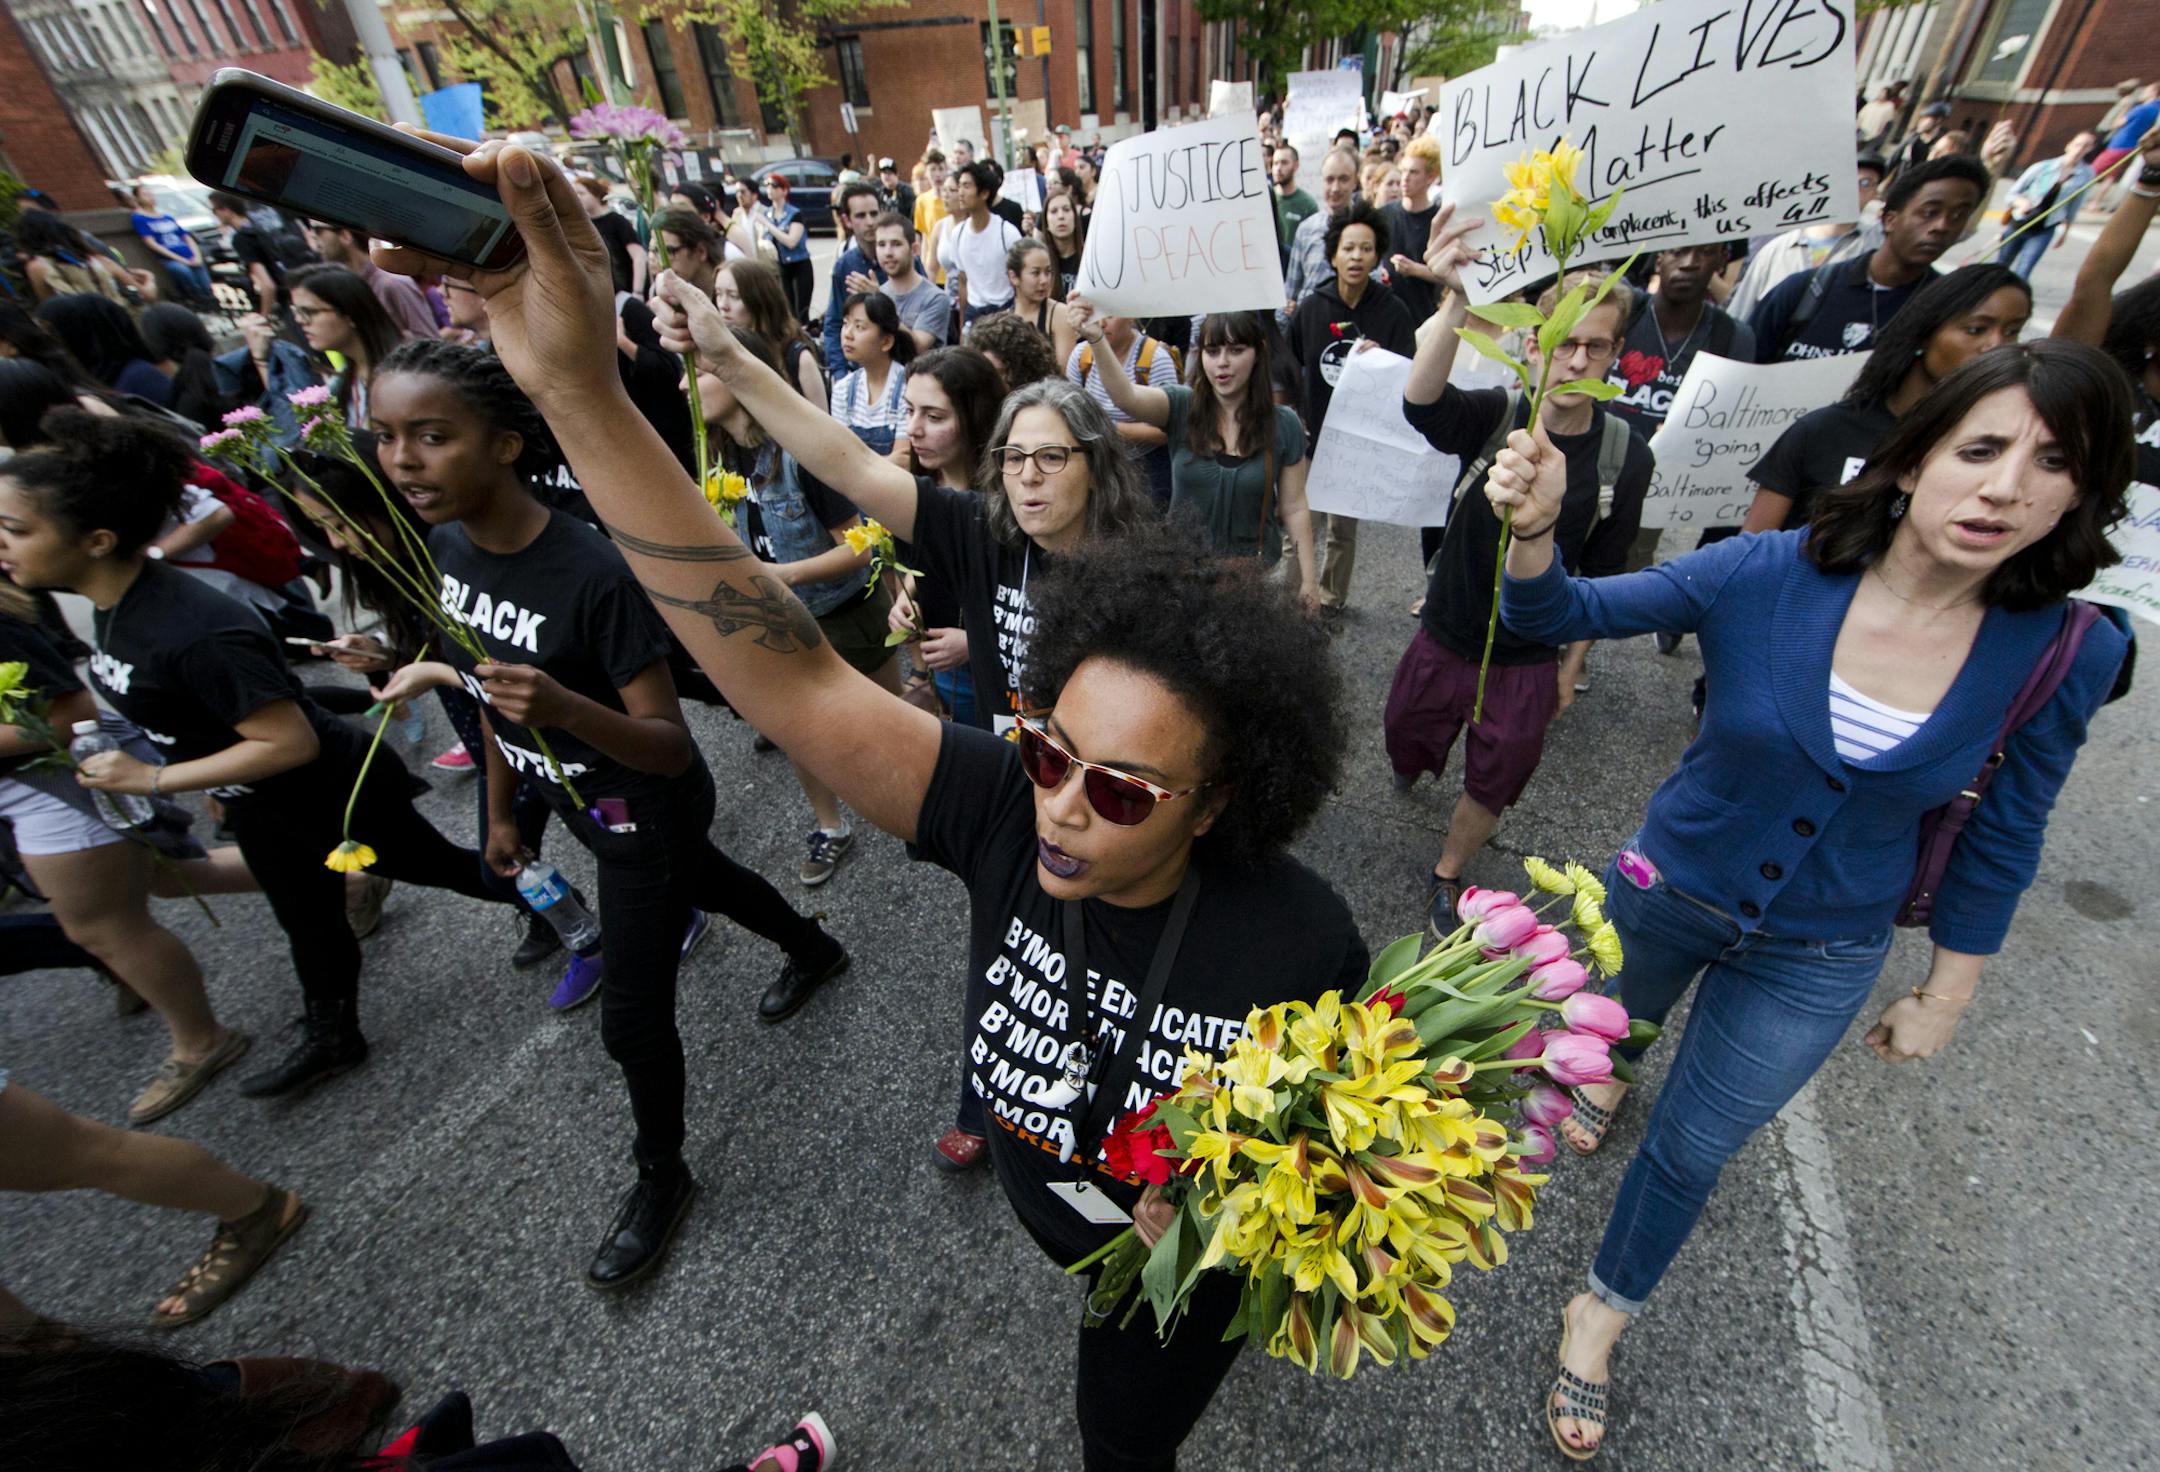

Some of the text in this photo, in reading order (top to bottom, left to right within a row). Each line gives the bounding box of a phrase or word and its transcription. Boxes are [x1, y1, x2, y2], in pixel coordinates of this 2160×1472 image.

[1452, 51, 1610, 167] BLACK
[1630, 0, 1847, 110] LIVES
[1129, 137, 1263, 213] JUSTICE
[1694, 194, 1728, 219] this
[1743, 171, 1831, 208] affects
[1133, 217, 1264, 282] PEACE
[1716, 217, 1752, 235] us
[1607, 375, 1675, 412] LAC
[1684, 379, 1808, 429] Baltimore
[1645, 471, 1733, 499] Baltimore
[1668, 504, 1694, 522] to
[441, 573, 547, 653] BLACK
[1003, 915, 1101, 1004] B'MOE
[985, 953, 1095, 1032] B'MOR
